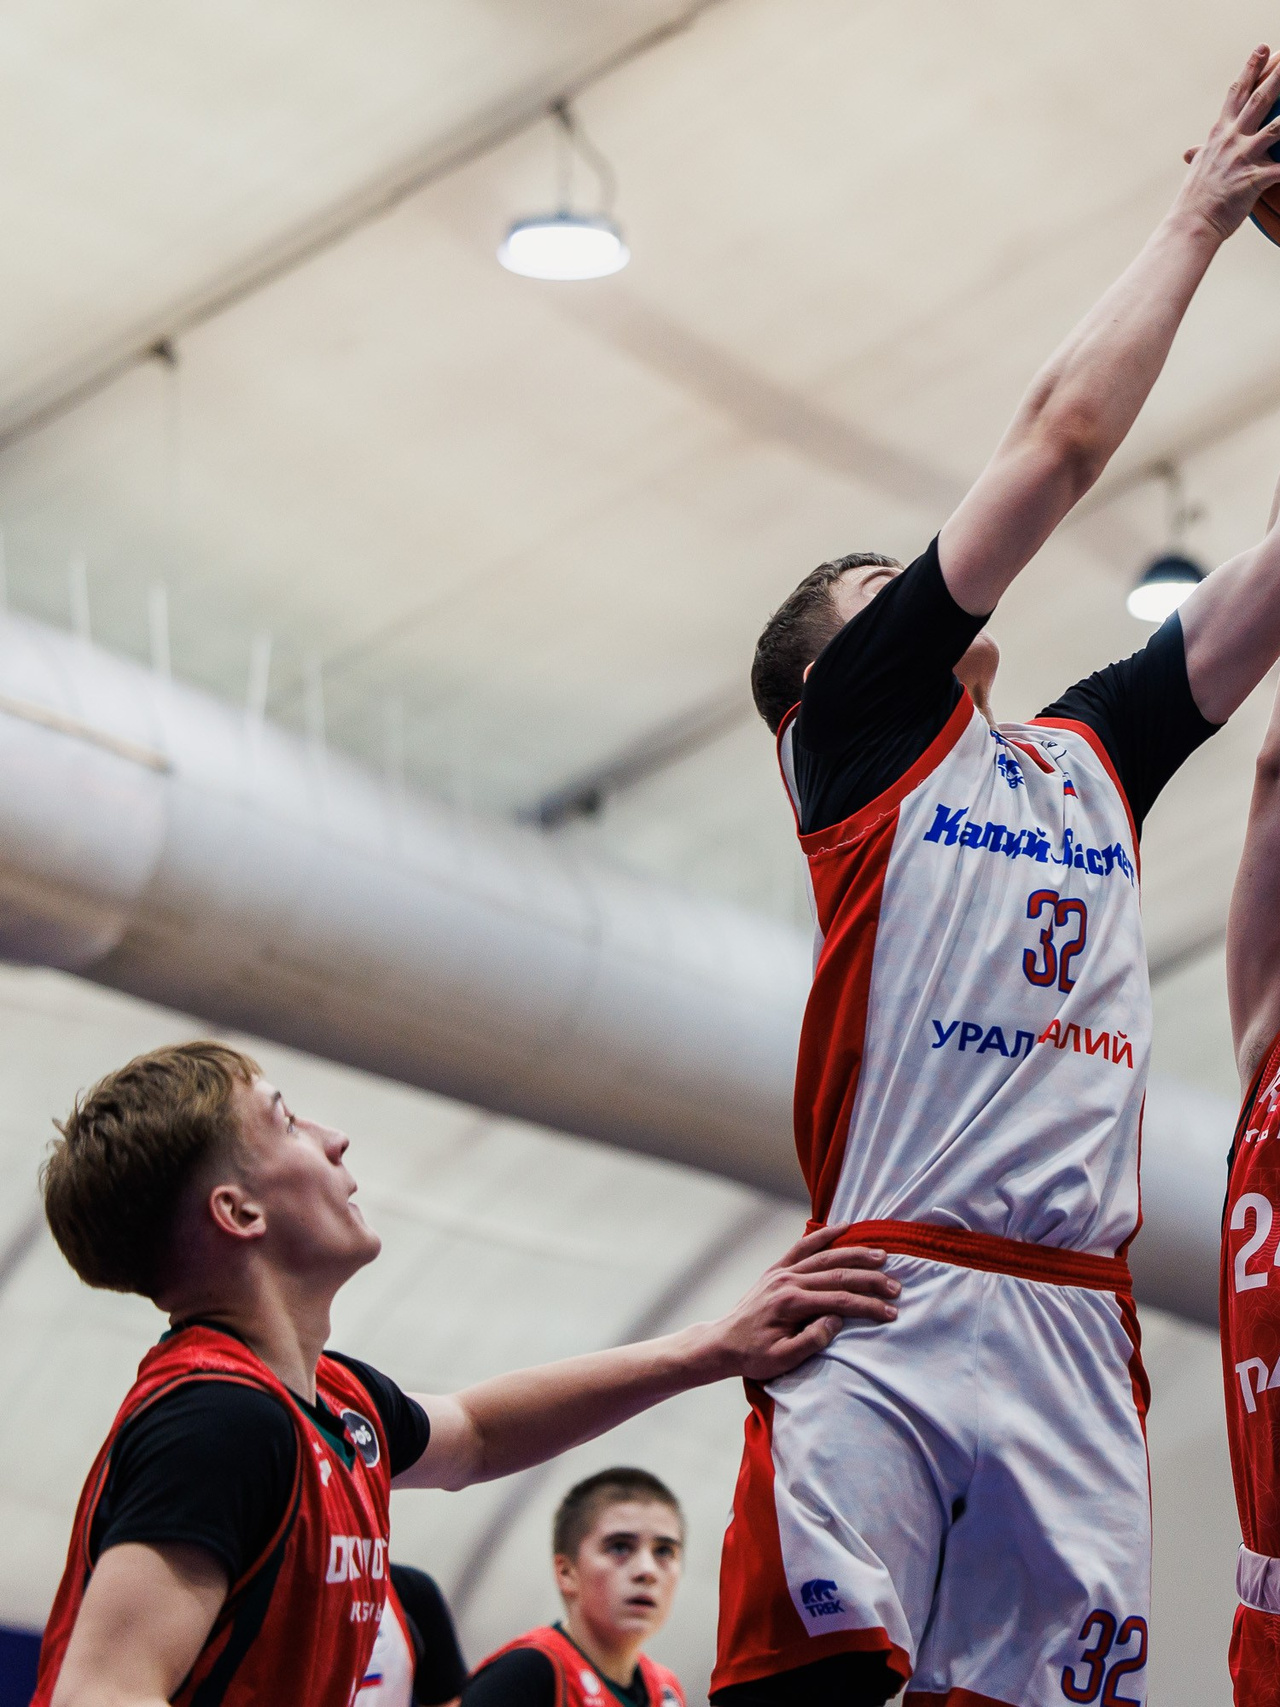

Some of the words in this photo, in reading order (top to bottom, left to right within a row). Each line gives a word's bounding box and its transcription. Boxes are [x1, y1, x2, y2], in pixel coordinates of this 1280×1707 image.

[1022, 889, 1088, 994] 32
[931, 1019, 1134, 1069] УРАЛАЛИЙ
[805, 1600, 845, 1618] TREK
[1061, 1608, 1149, 1707] 32
